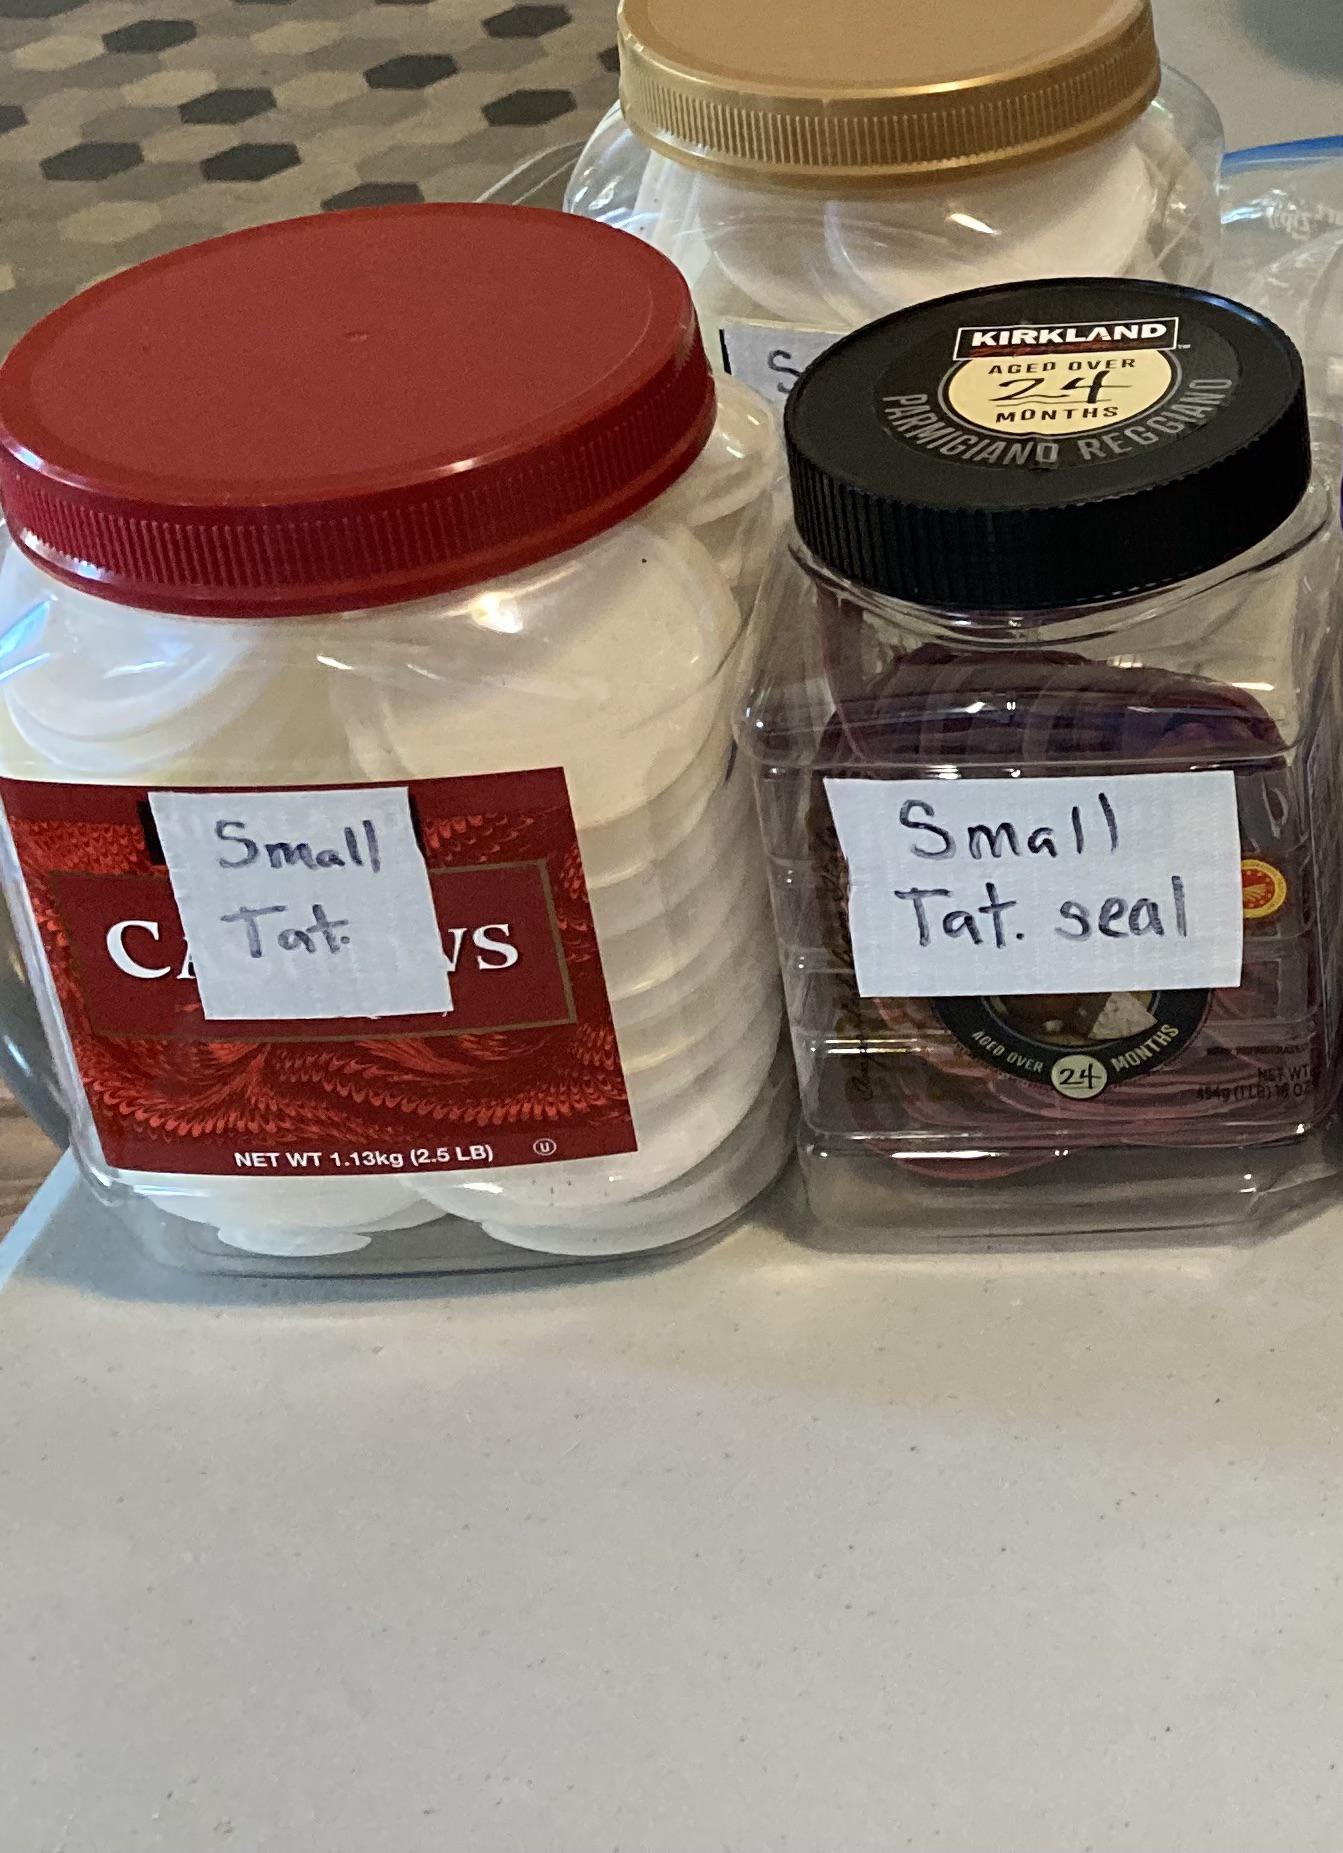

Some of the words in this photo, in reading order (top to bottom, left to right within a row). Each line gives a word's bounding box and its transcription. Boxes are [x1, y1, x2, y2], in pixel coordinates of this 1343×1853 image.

[971, 323, 1168, 347] KIRKLAND
[988, 361, 1056, 375] AGED
[1068, 358, 1136, 371] OVER
[988, 369, 1133, 405] 24
[882, 393, 1060, 465] PARMIGIANO
[1077, 379, 1233, 461] REGGIANO
[995, 406, 1120, 423] MONTHS
[214, 820, 381, 874] Small
[898, 792, 1119, 861] Small
[219, 904, 351, 958] Tat.
[894, 882, 1026, 949] Tat.
[1054, 875, 1188, 942] seal
[971, 1030, 1006, 1058] AGED
[1005, 1052, 1045, 1074] OVER
[1057, 1062, 1102, 1091] 24
[1109, 1023, 1181, 1073] MONTHS
[1258, 1067, 1284, 1082] NET
[234, 1152, 280, 1168] NET
[285, 1152, 322, 1167] WT
[330, 1151, 403, 1168] 1.13kg
[410, 1147, 450, 1167] (2.5
[456, 1144, 494, 1162] LB)
